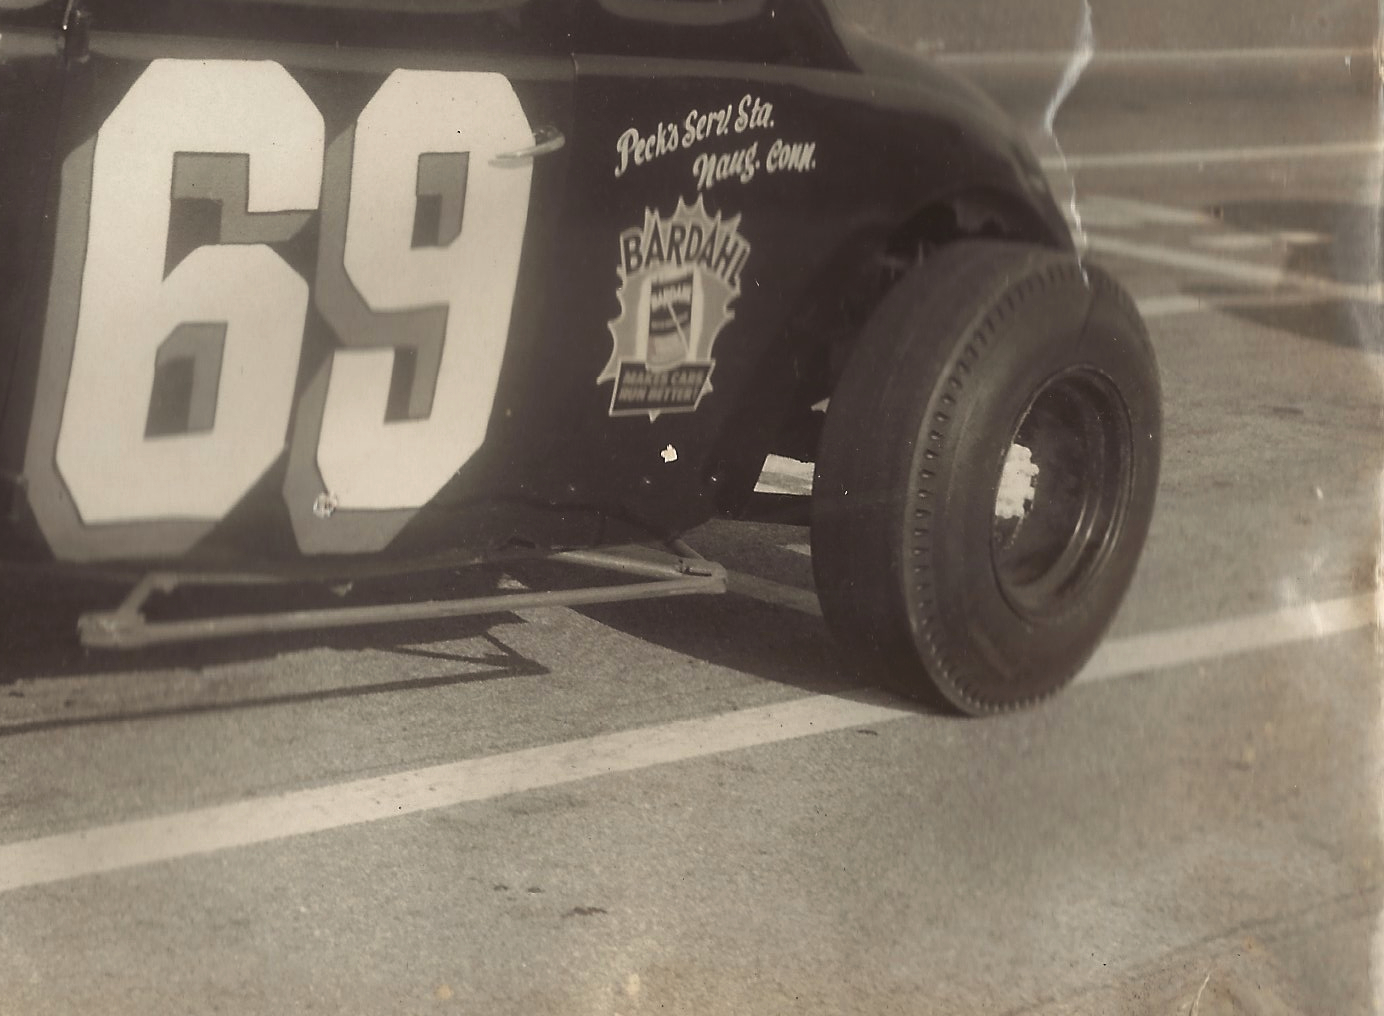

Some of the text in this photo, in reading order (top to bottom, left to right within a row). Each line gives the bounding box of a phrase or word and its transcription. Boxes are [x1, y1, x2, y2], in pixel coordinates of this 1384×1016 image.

[614, 121, 679, 178] Peck's
[734, 94, 775, 133] Sta.
[54, 58, 535, 526] 69
[622, 221, 748, 287] BARDAHL
